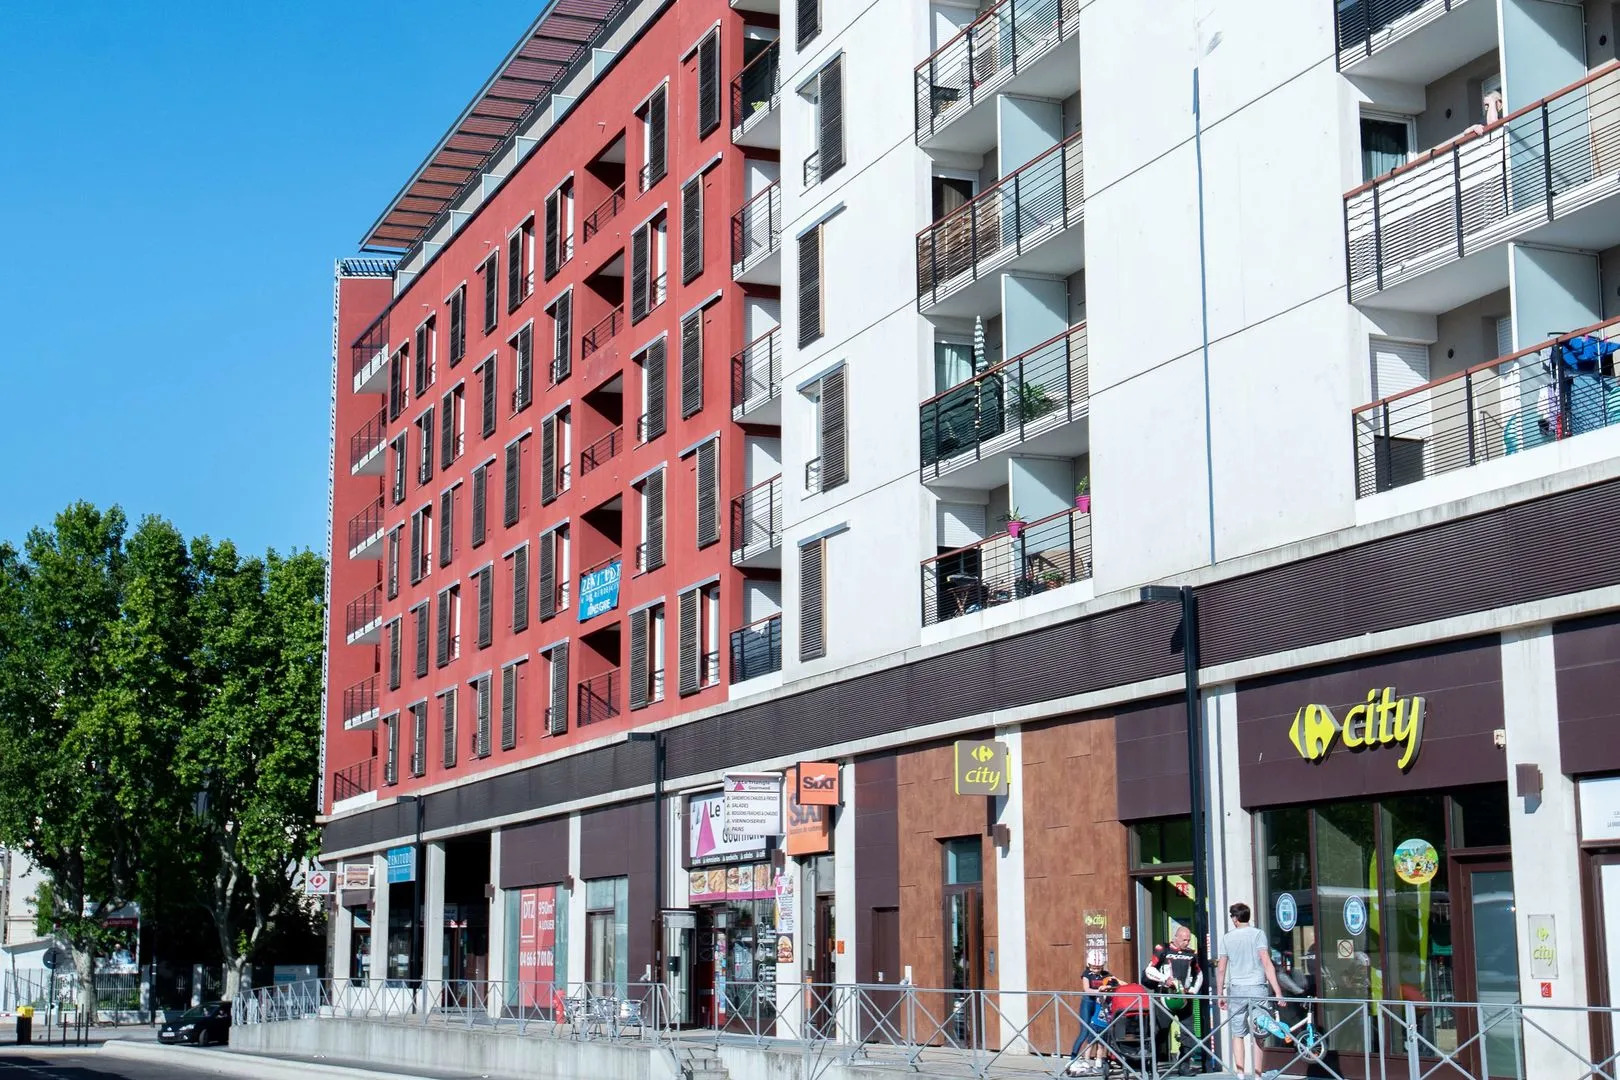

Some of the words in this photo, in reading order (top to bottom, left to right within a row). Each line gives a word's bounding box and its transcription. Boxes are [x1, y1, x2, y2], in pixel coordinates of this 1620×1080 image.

[1343, 686, 1424, 769] city
[965, 766, 1001, 791] city
[709, 802, 721, 818] Le
[1533, 945, 1554, 967] city
